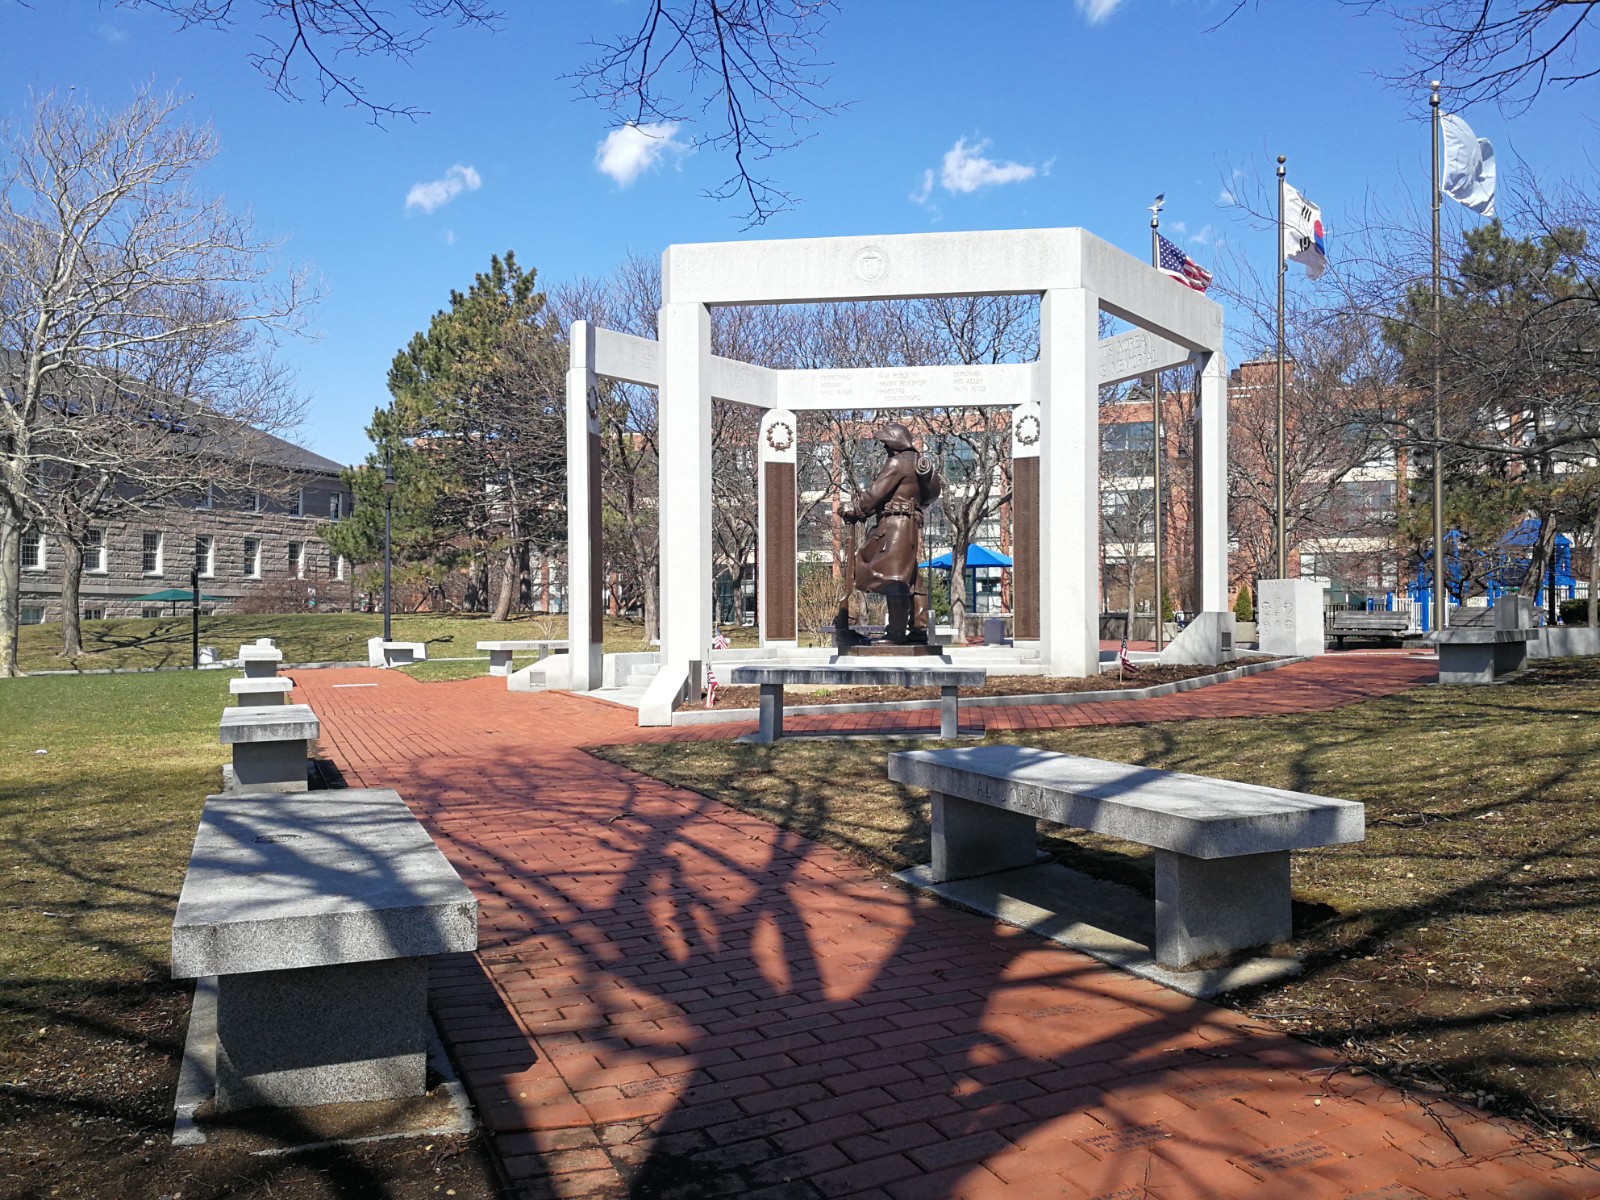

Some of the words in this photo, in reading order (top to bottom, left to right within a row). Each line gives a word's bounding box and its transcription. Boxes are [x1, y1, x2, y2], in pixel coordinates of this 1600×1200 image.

[1117, 332, 1153, 355] KOREAN
[1111, 349, 1159, 374] MEMORIAL
[977, 780, 992, 799] AL
[1000, 786, 1060, 816] JOLSON
